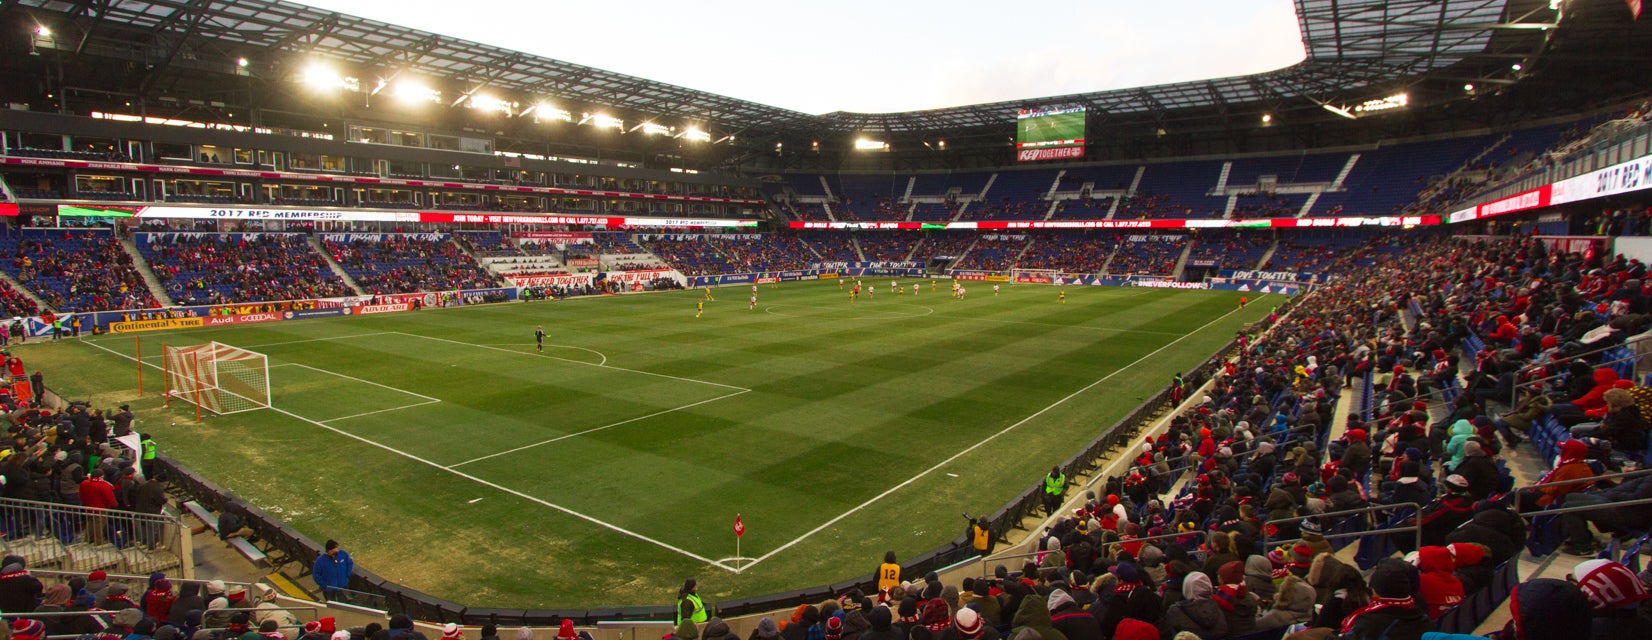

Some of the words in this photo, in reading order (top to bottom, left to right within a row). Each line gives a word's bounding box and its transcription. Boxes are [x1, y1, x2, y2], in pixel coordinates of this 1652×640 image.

[1597, 168, 1619, 193] 2017
[1620, 163, 1640, 188] RED
[210, 209, 243, 218] 2017
[453, 214, 466, 222] JOIN
[324, 233, 346, 242] WITH
[348, 233, 381, 242] PASSION
[1231, 270, 1255, 280] LOVE
[515, 278, 525, 288] WE
[527, 276, 540, 287] ARE
[541, 275, 555, 286] RED
[557, 275, 589, 285] TOGETHER
[361, 303, 408, 314] ADVOCARE
[211, 316, 234, 325] Audi
[113, 320, 169, 333] Continental
[885, 568, 896, 580] 12
